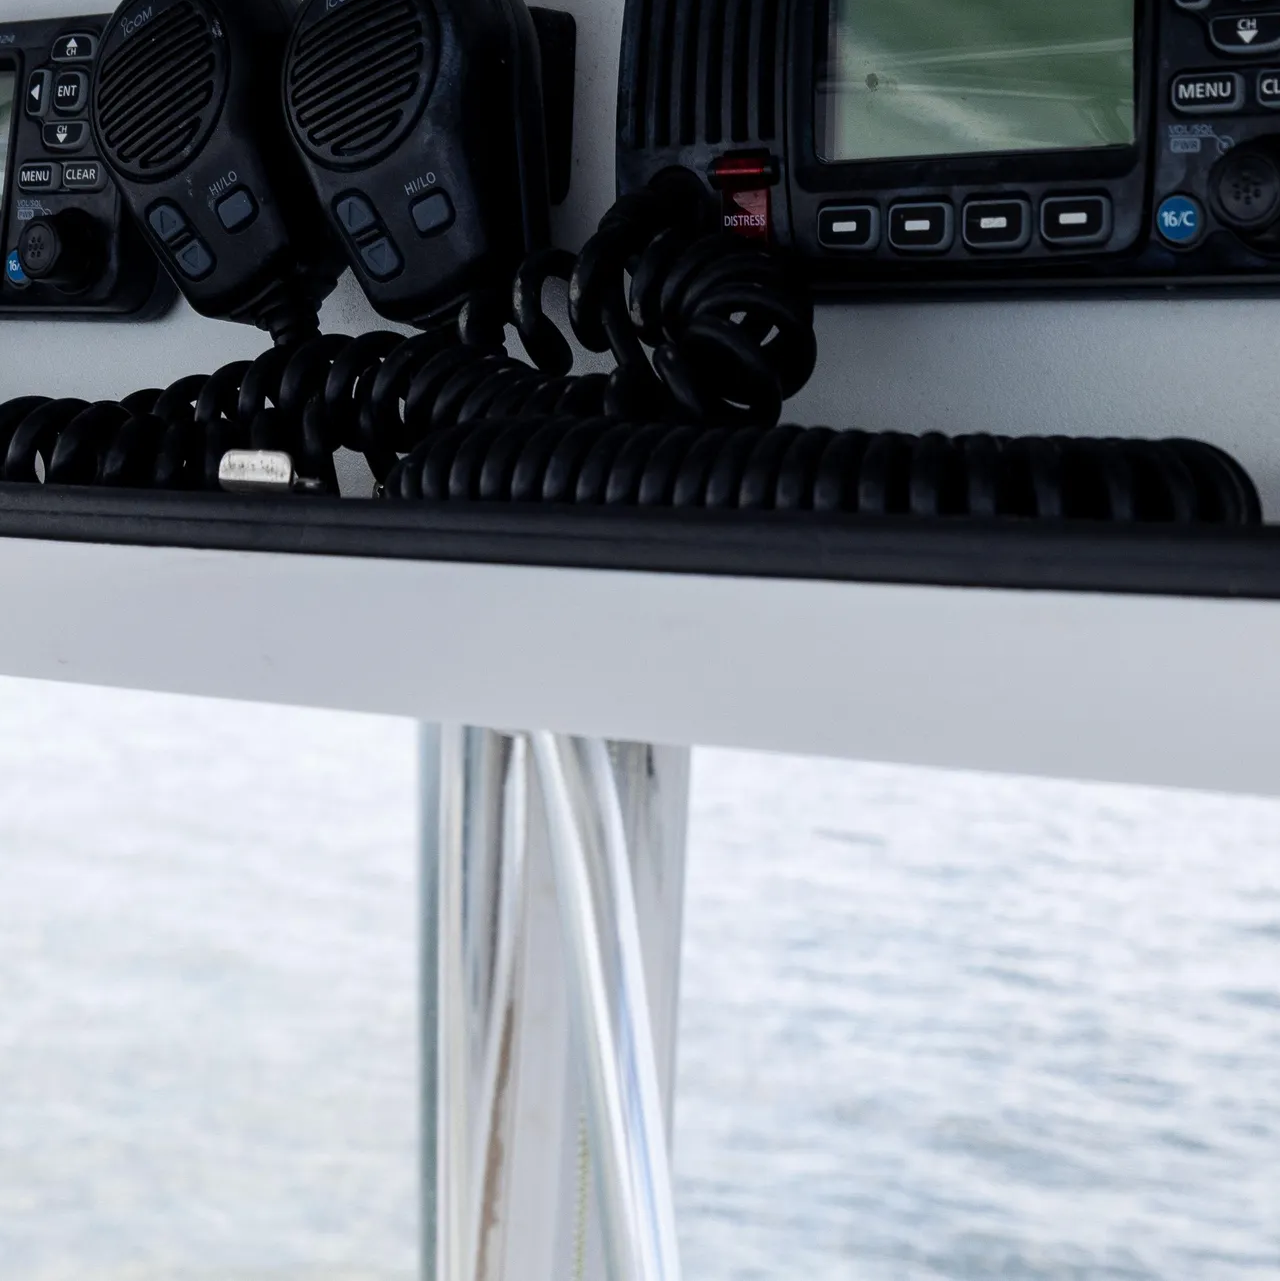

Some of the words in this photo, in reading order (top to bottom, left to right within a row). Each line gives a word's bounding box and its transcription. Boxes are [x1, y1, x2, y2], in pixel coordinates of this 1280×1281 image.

[1237, 18, 1258, 30] CH
[65, 47, 77, 57] CH
[57, 85, 78, 98] ENT
[1177, 81, 1232, 100] MENU
[56, 125, 68, 134] CH
[21, 170, 50, 183] MENU
[65, 168, 96, 181] CLEAR
[208, 170, 239, 196] HI/LO
[403, 171, 437, 196] HI/LO
[723, 214, 766, 227] DISTRESS
[1161, 210, 1195, 228] 16/C
